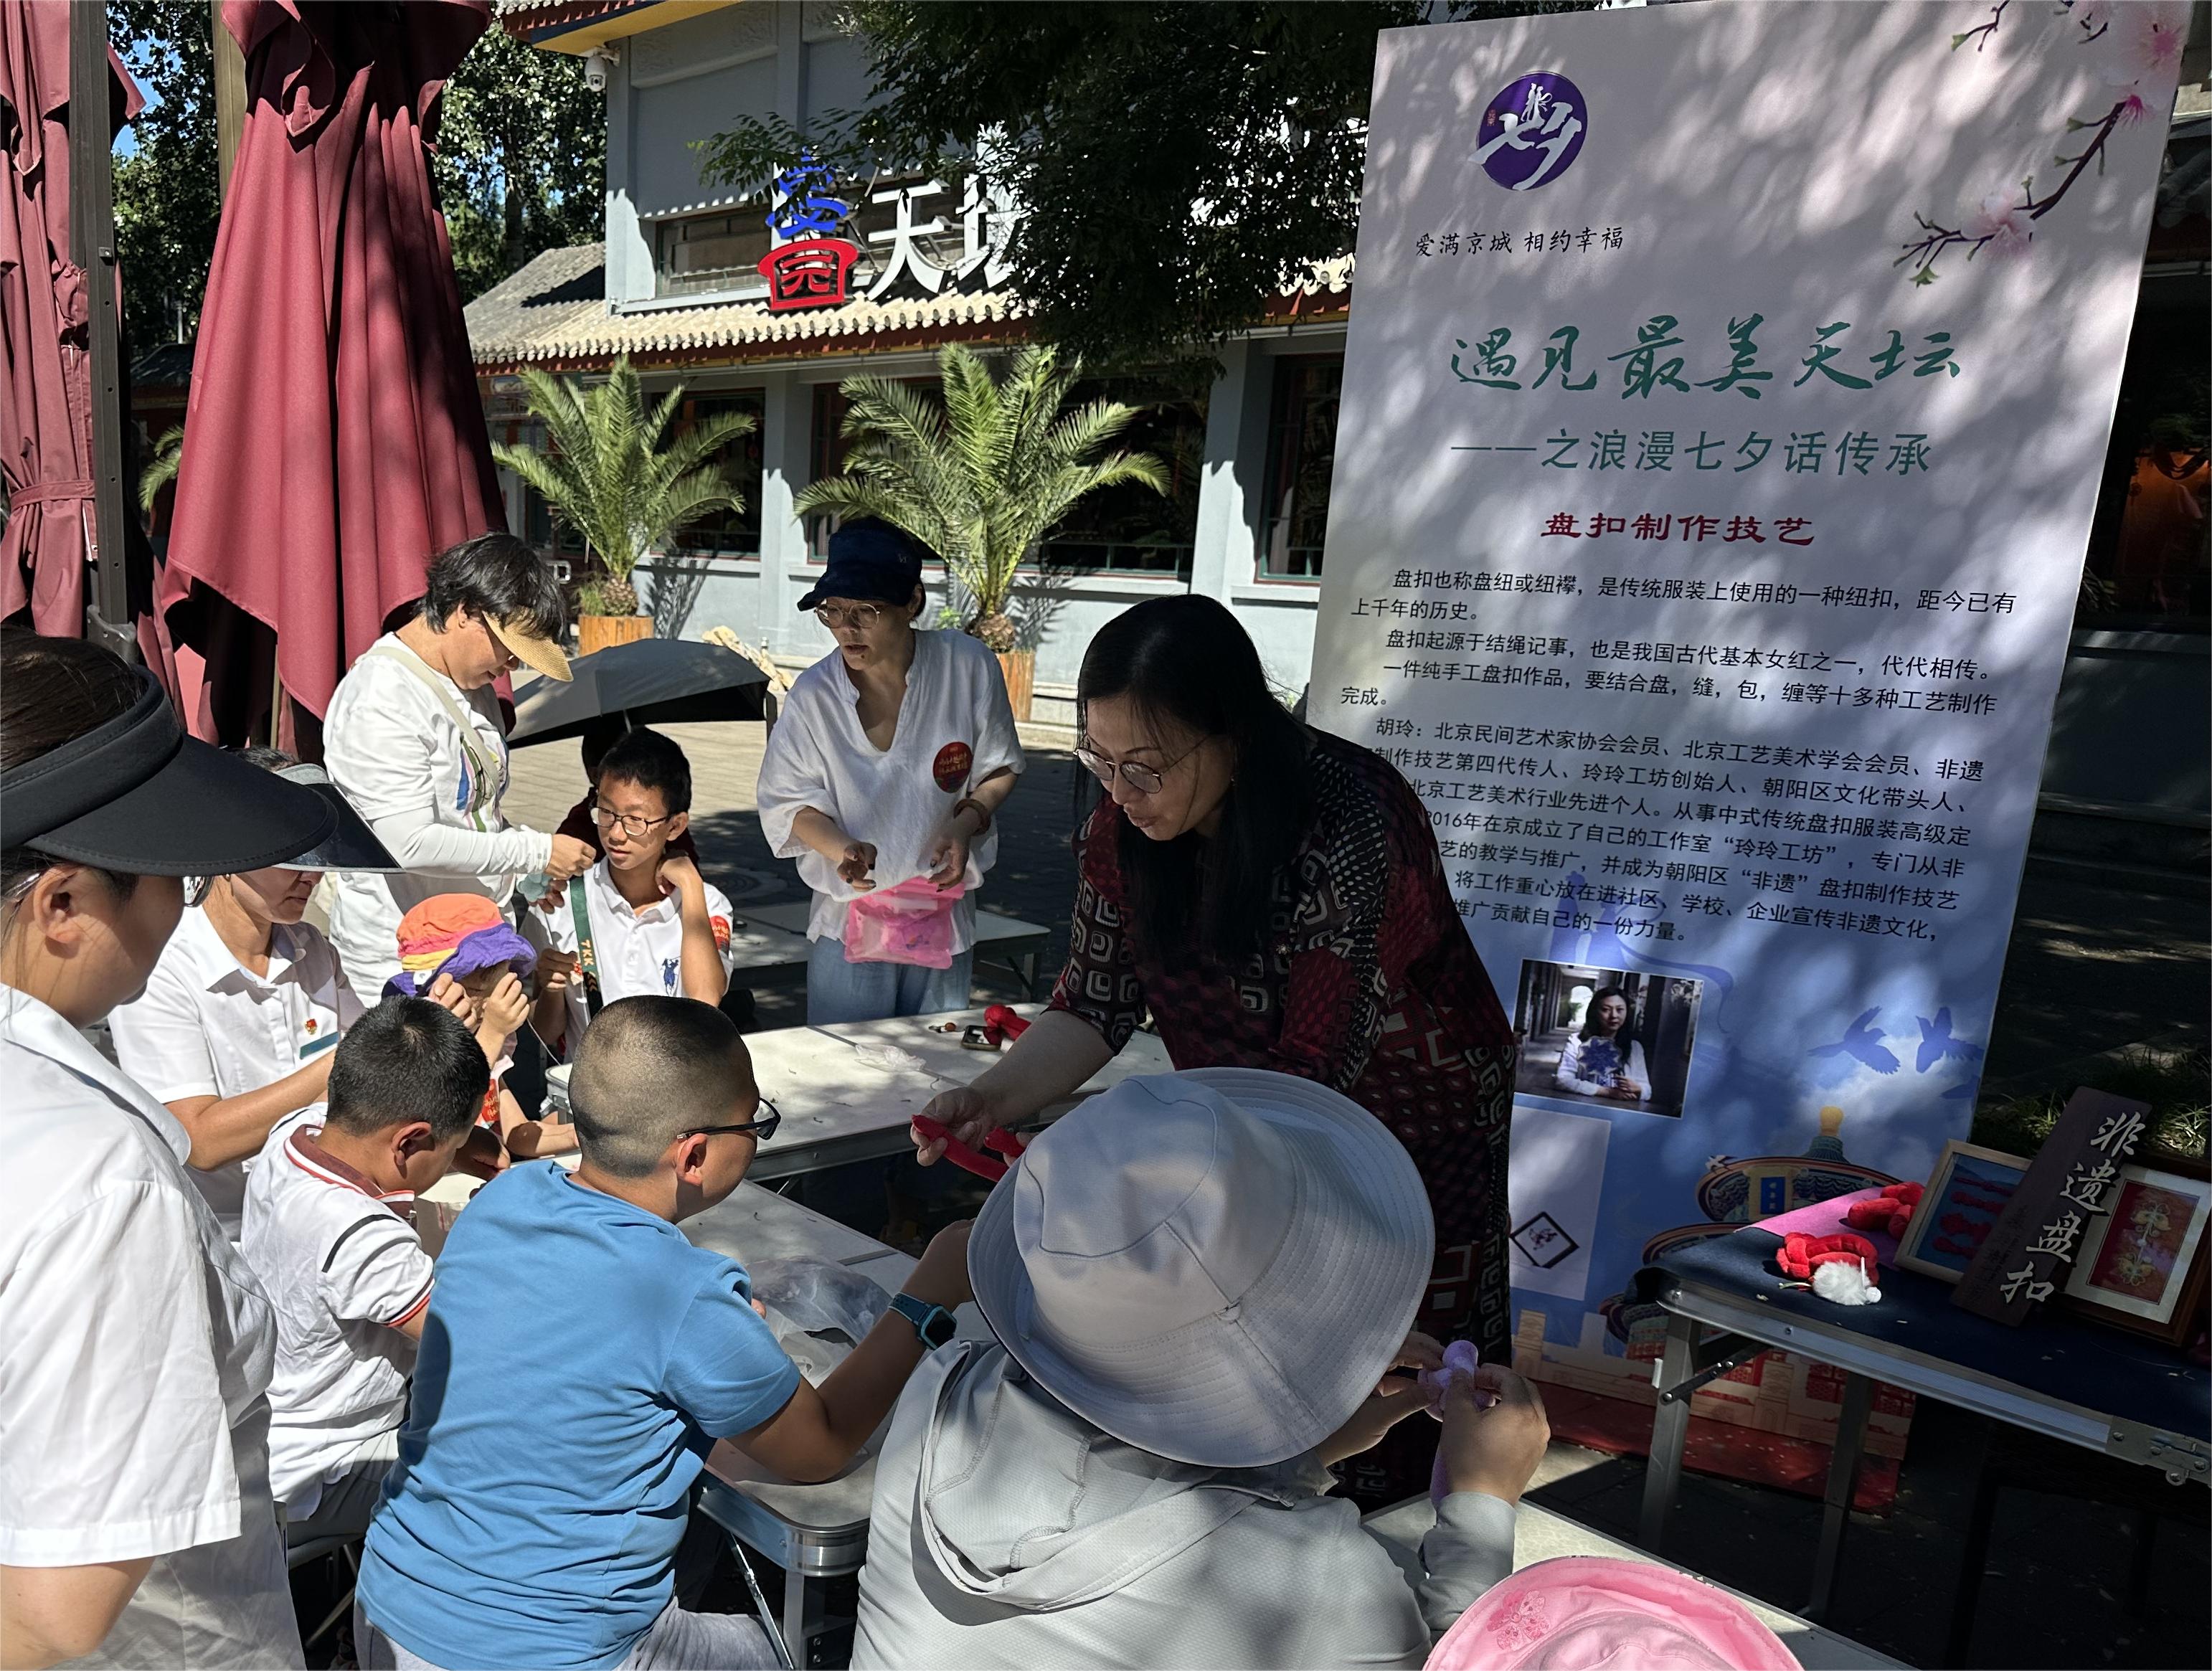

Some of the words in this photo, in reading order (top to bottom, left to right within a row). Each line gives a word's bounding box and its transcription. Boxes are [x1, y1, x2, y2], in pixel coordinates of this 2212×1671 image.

[1416, 231, 1513, 257] 爱满京城
[1524, 227, 1623, 253] 相约幸福
[1451, 313, 1960, 399] 遇见最美天坛
[1541, 511, 1815, 546] 盘扣制作技艺
[1351, 597, 1478, 621] 上千年的历史。
[1386, 629, 1990, 681] 盘扣起源于结绳记事，也是我国古代基本女红之一，代代相传。
[1341, 686, 1387, 706] 完成。
[1383, 659, 1998, 716] 一件纯手工盘扣作品，要结合盘，缝，包，缠等十多种工艺制作
[1376, 717, 1985, 782] 胡玲：北京民间艺术家协会会员、北京工艺美术学会会员、非遗
[1369, 747, 1965, 813] 制作技艺第四代传人、玲玲工坊创始人、朝阳区文化带头人、
[1455, 870, 1937, 942] 将工作重心放在进社区、学校、企业宣传非遗文化，
[2000, 1111, 2146, 1303] 非遗盘扣
